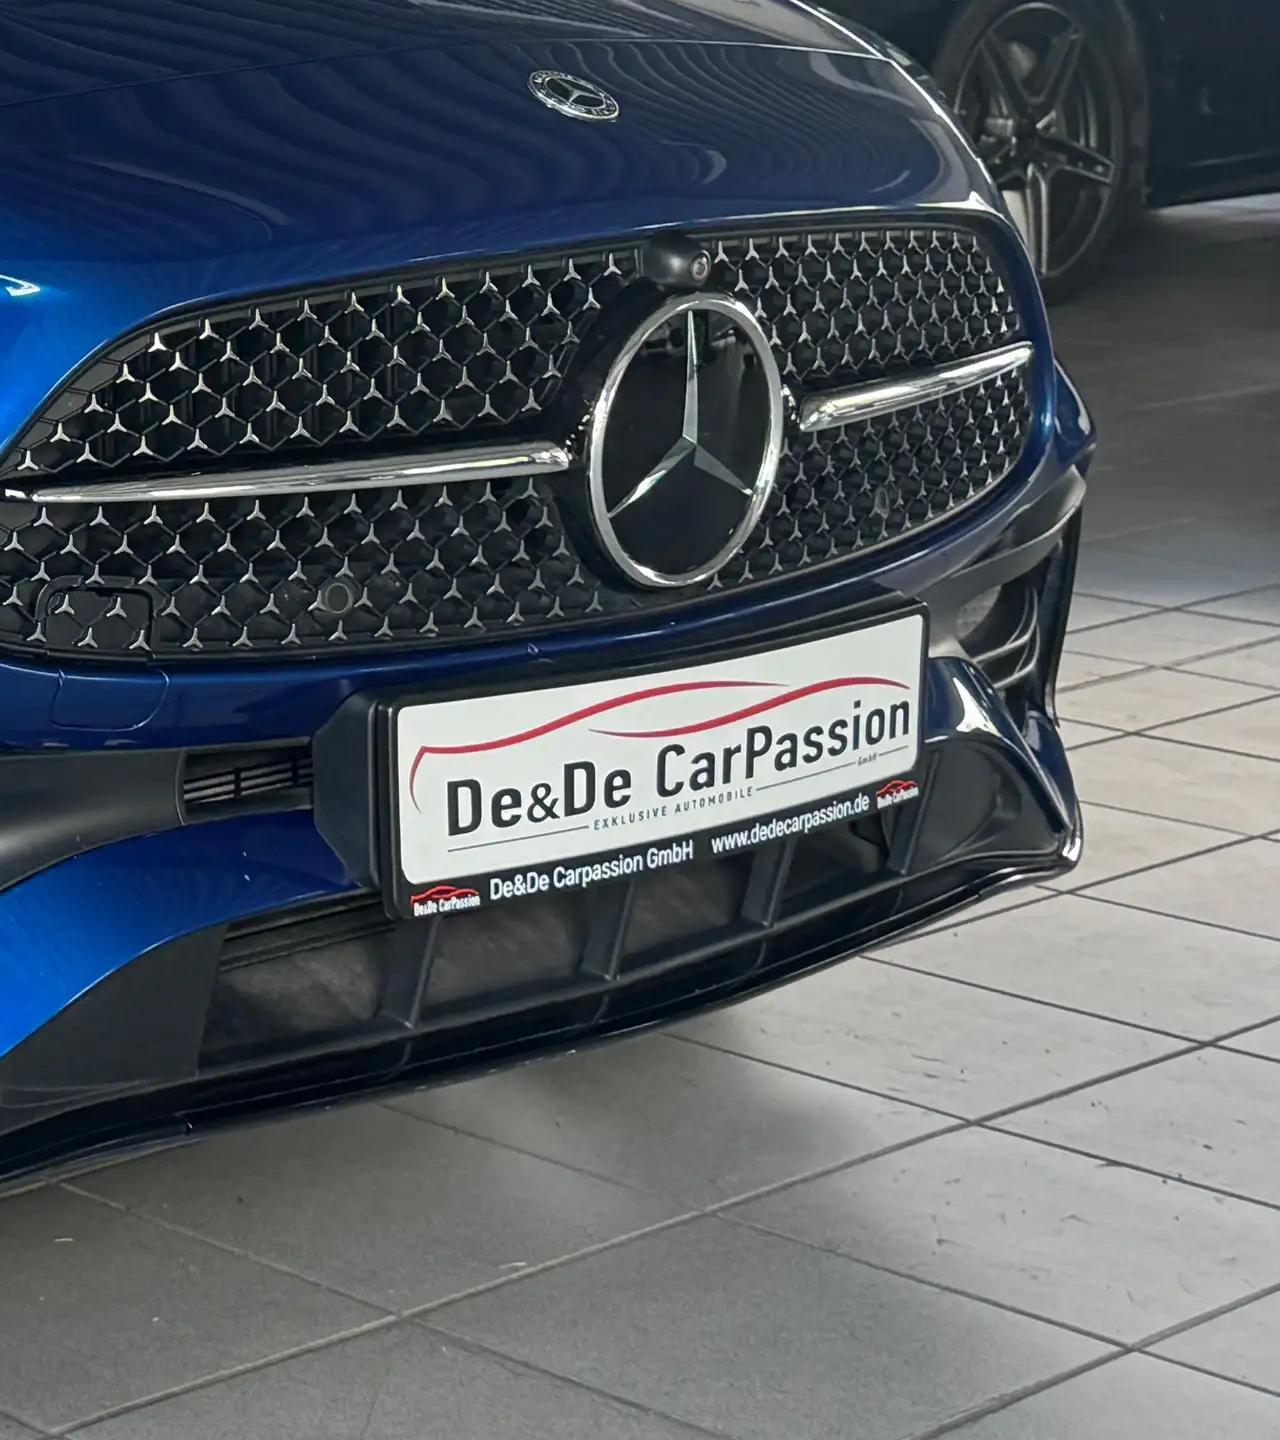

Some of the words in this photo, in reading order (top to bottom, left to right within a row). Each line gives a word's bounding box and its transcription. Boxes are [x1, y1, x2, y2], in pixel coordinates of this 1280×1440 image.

[447, 761, 632, 836] De&De
[656, 699, 910, 798] CarPassion
[594, 805, 667, 831] EXKLUSIVE
[675, 786, 753, 814] AUTOMOBILE
[490, 872, 550, 900] De&De
[553, 854, 643, 888] Carpassion
[646, 839, 693, 869] GmbH
[711, 792, 870, 854] www.dedecarpassion.de
